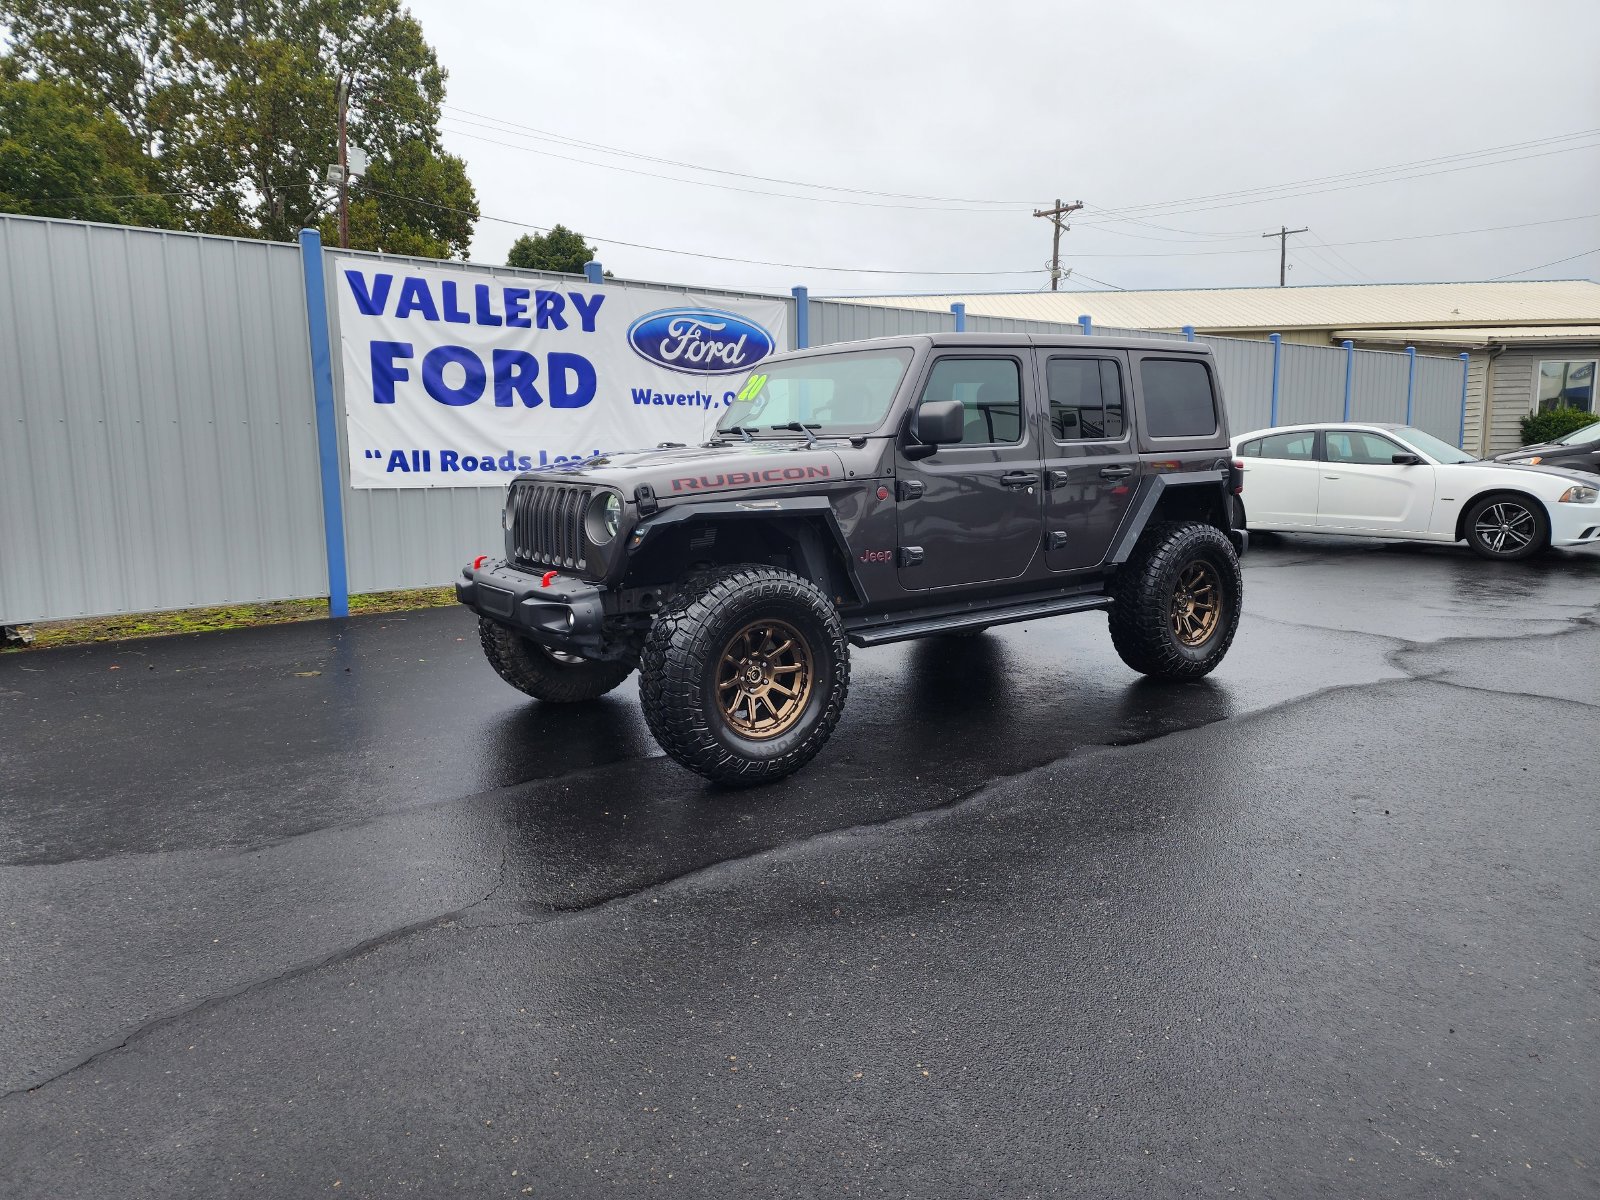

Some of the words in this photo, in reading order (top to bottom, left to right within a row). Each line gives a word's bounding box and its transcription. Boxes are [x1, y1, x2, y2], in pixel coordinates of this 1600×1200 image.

[344, 270, 606, 332] VALLERY
[659, 317, 748, 364] Ford
[369, 340, 597, 409] FORD
[738, 374, 767, 401] 20
[631, 388, 719, 410] Waverly,
[440, 450, 533, 473] Roads
[671, 465, 831, 491] RUBICON
[859, 549, 893, 564] Jeep
